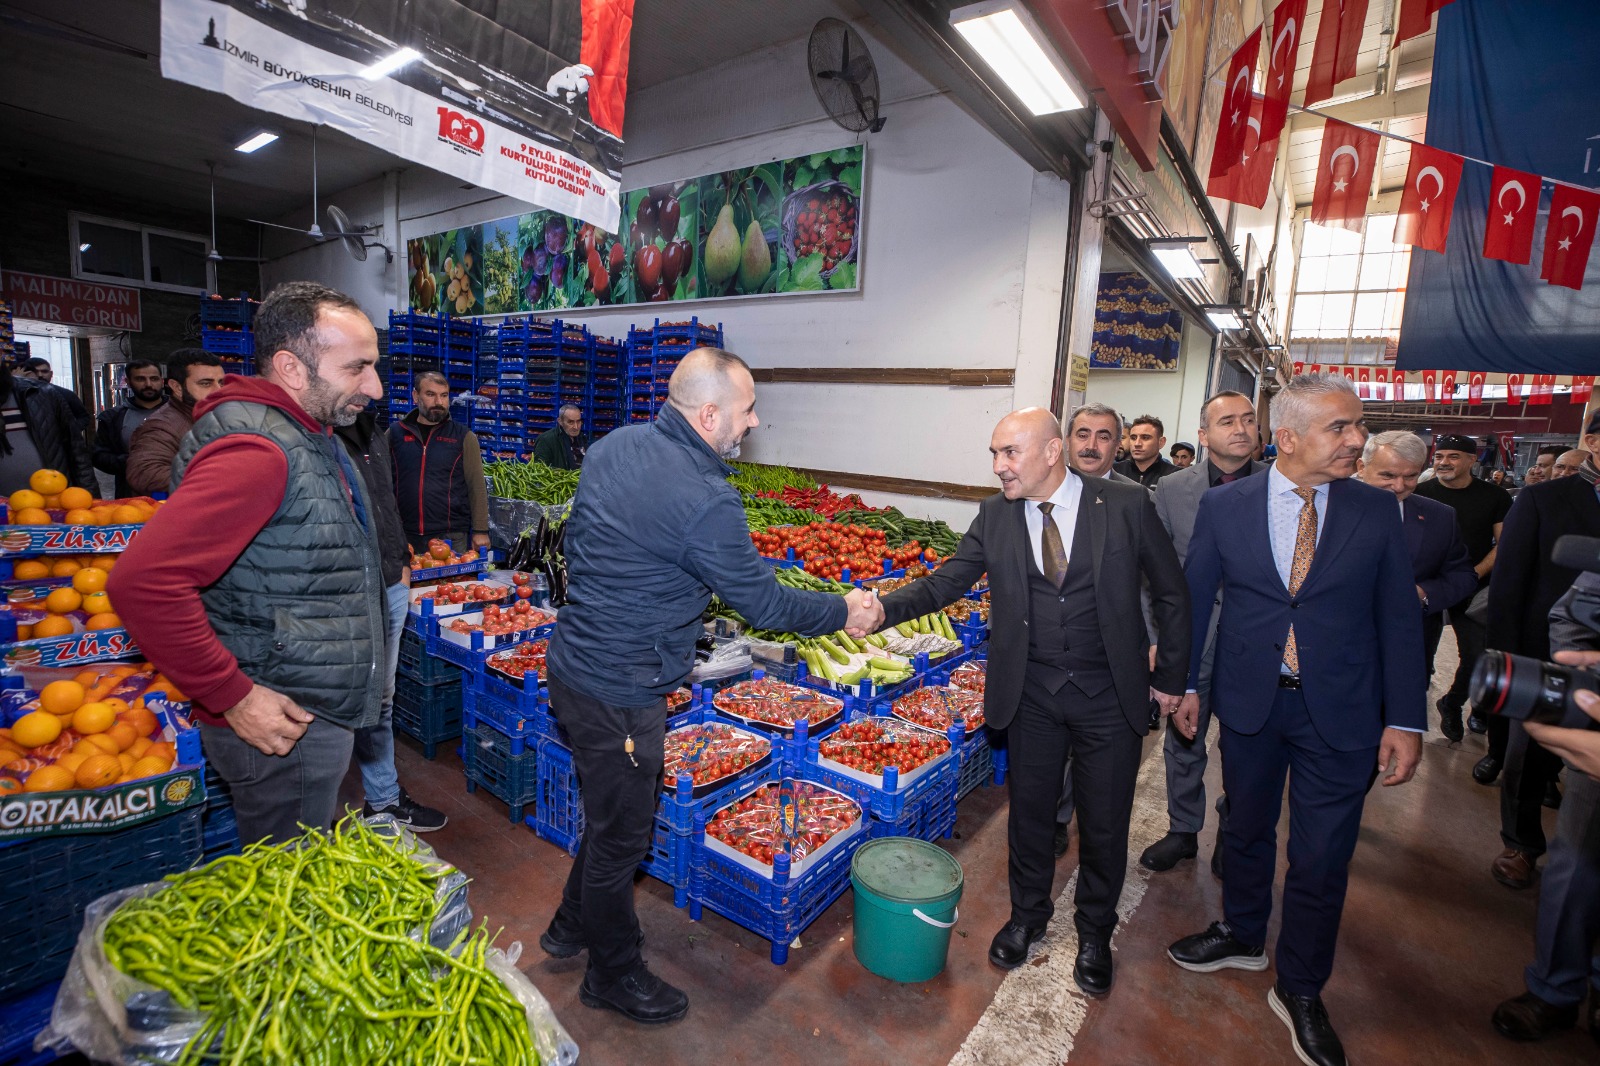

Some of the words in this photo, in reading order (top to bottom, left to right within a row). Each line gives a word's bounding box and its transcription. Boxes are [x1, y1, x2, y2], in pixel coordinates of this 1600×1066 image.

[263, 60, 351, 100] BÜYÜKŞEHİR
[500, 145, 575, 182] KURTULUŞUNUN
[576, 176, 591, 190] 100.
[592, 183, 606, 197] YILI
[520, 143, 527, 152] 9
[528, 146, 558, 165] EYLÜL
[559, 155, 592, 179] İZMİR'İN
[525, 167, 556, 185] KUTLU
[557, 179, 585, 197] OLSUN
[9, 274, 130, 306] MALIMIZDAN
[71, 307, 139, 329] GÖRÜN
[0, 786, 156, 827] ORTAKALCI
